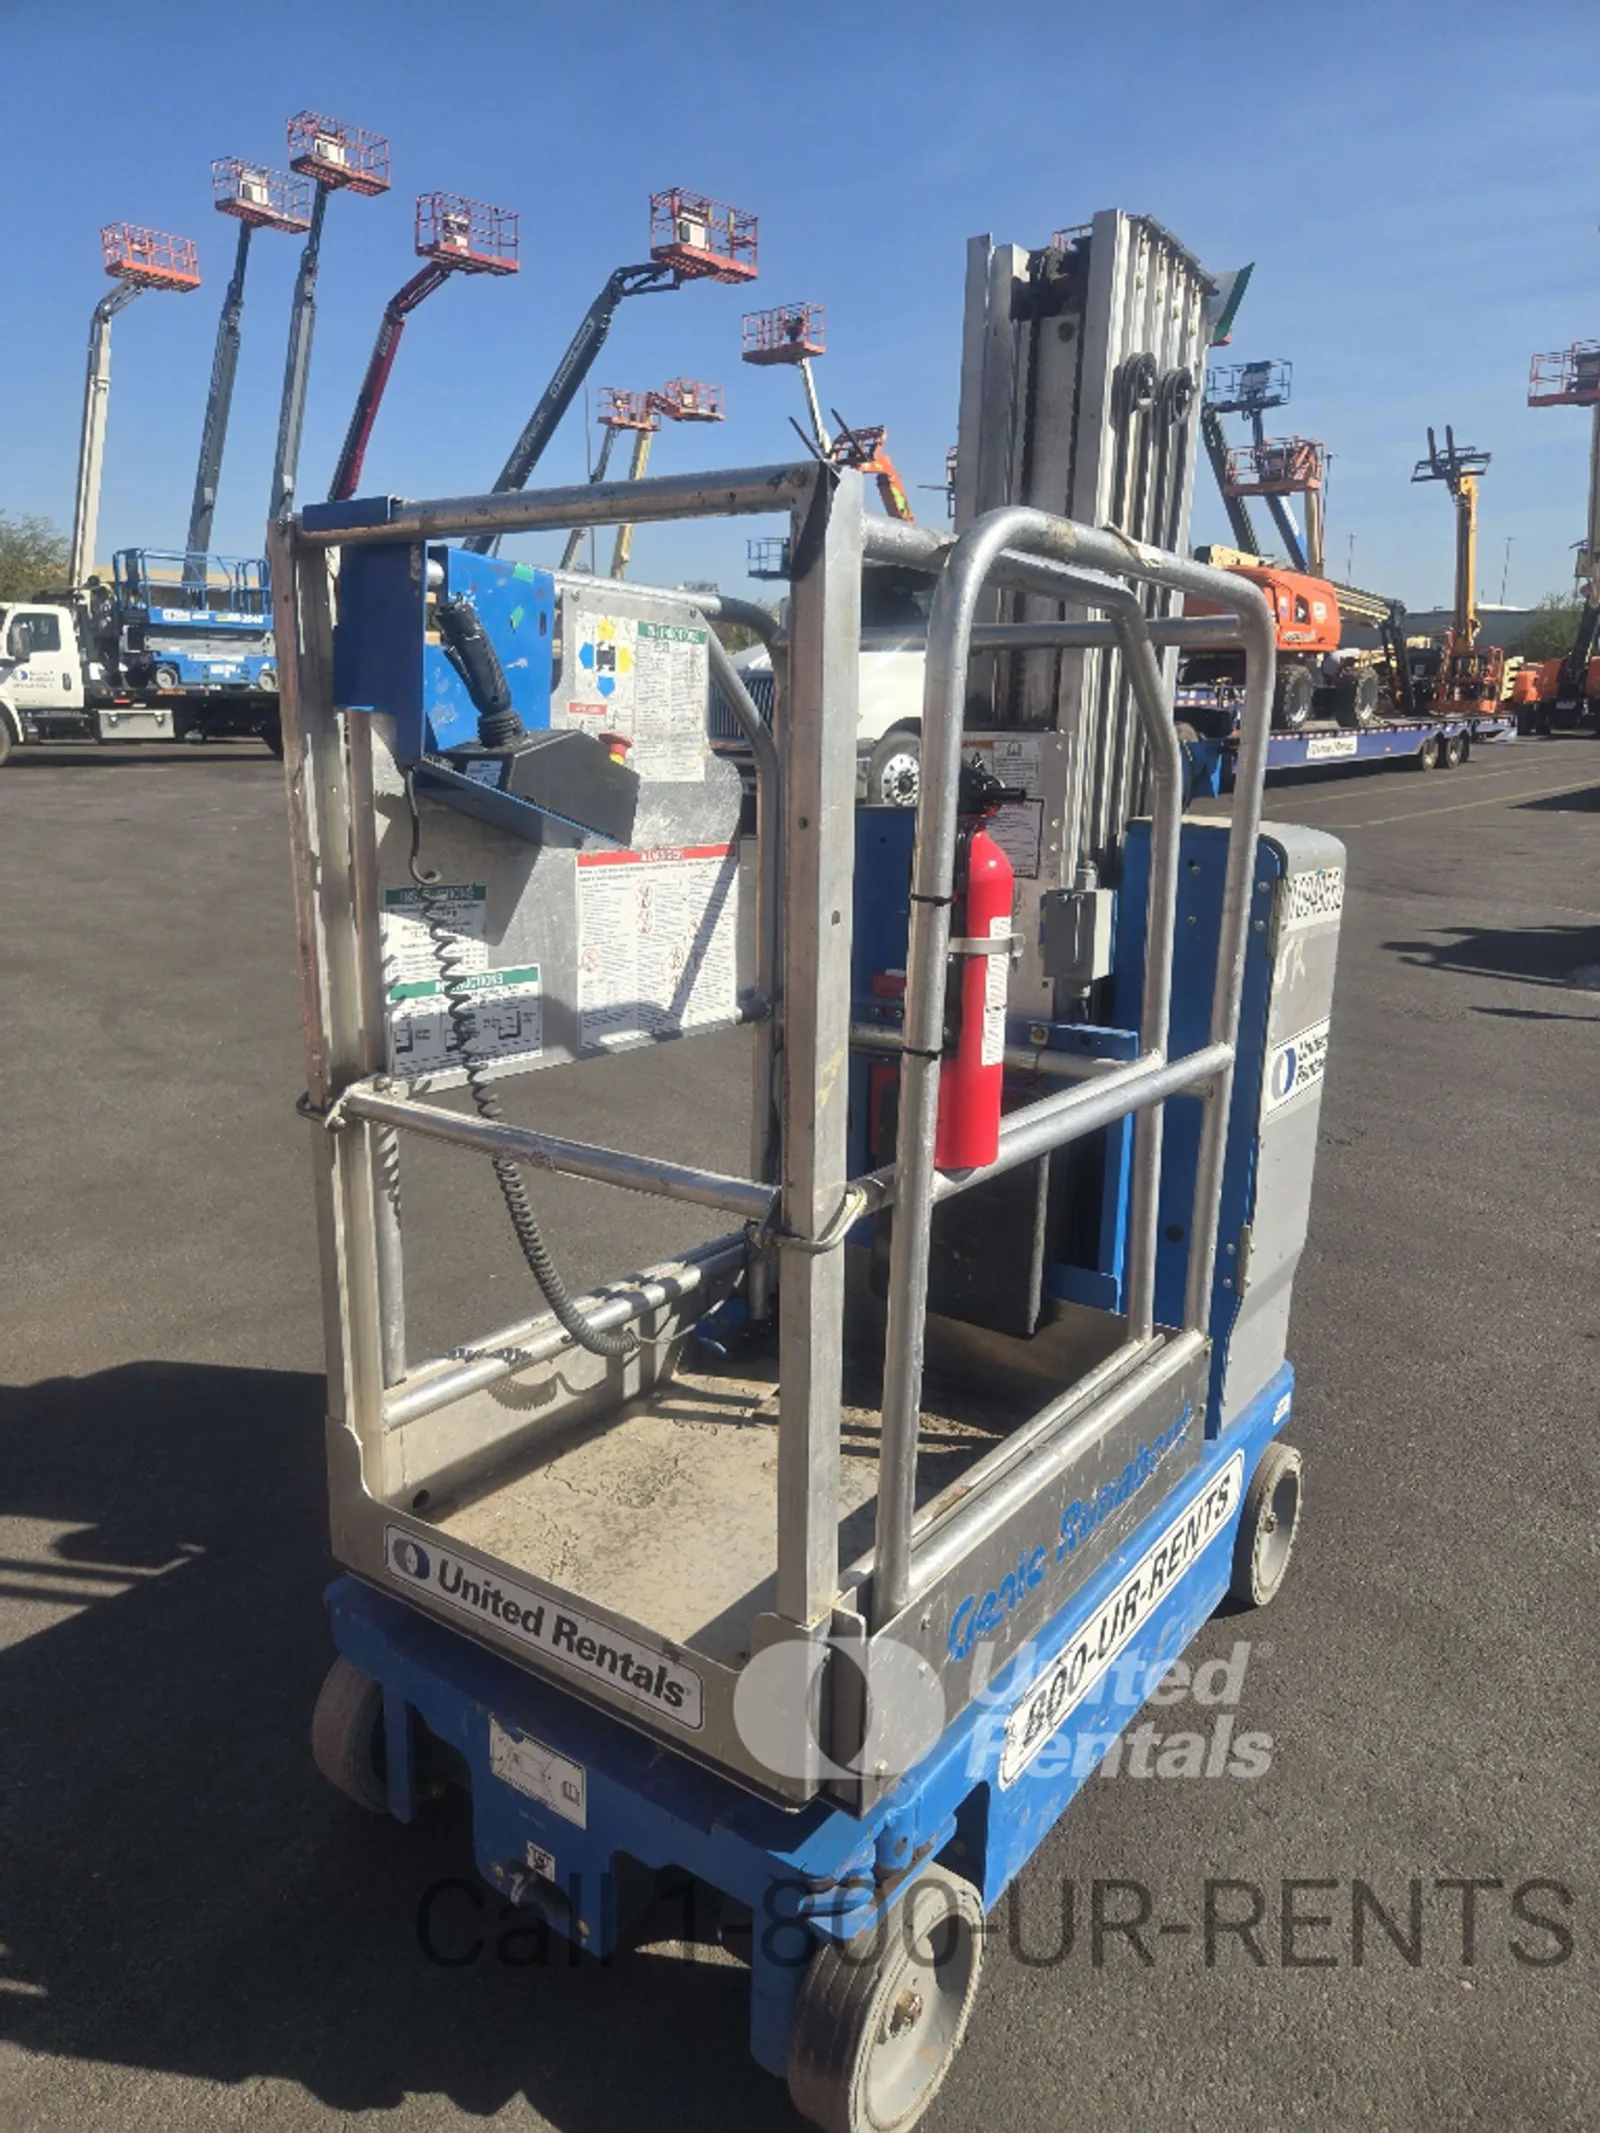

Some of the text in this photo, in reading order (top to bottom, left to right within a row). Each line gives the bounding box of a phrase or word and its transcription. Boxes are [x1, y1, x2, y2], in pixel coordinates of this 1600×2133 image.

[438, 1557, 685, 1709] United Rentals
[947, 1545, 1046, 1661] Genie
